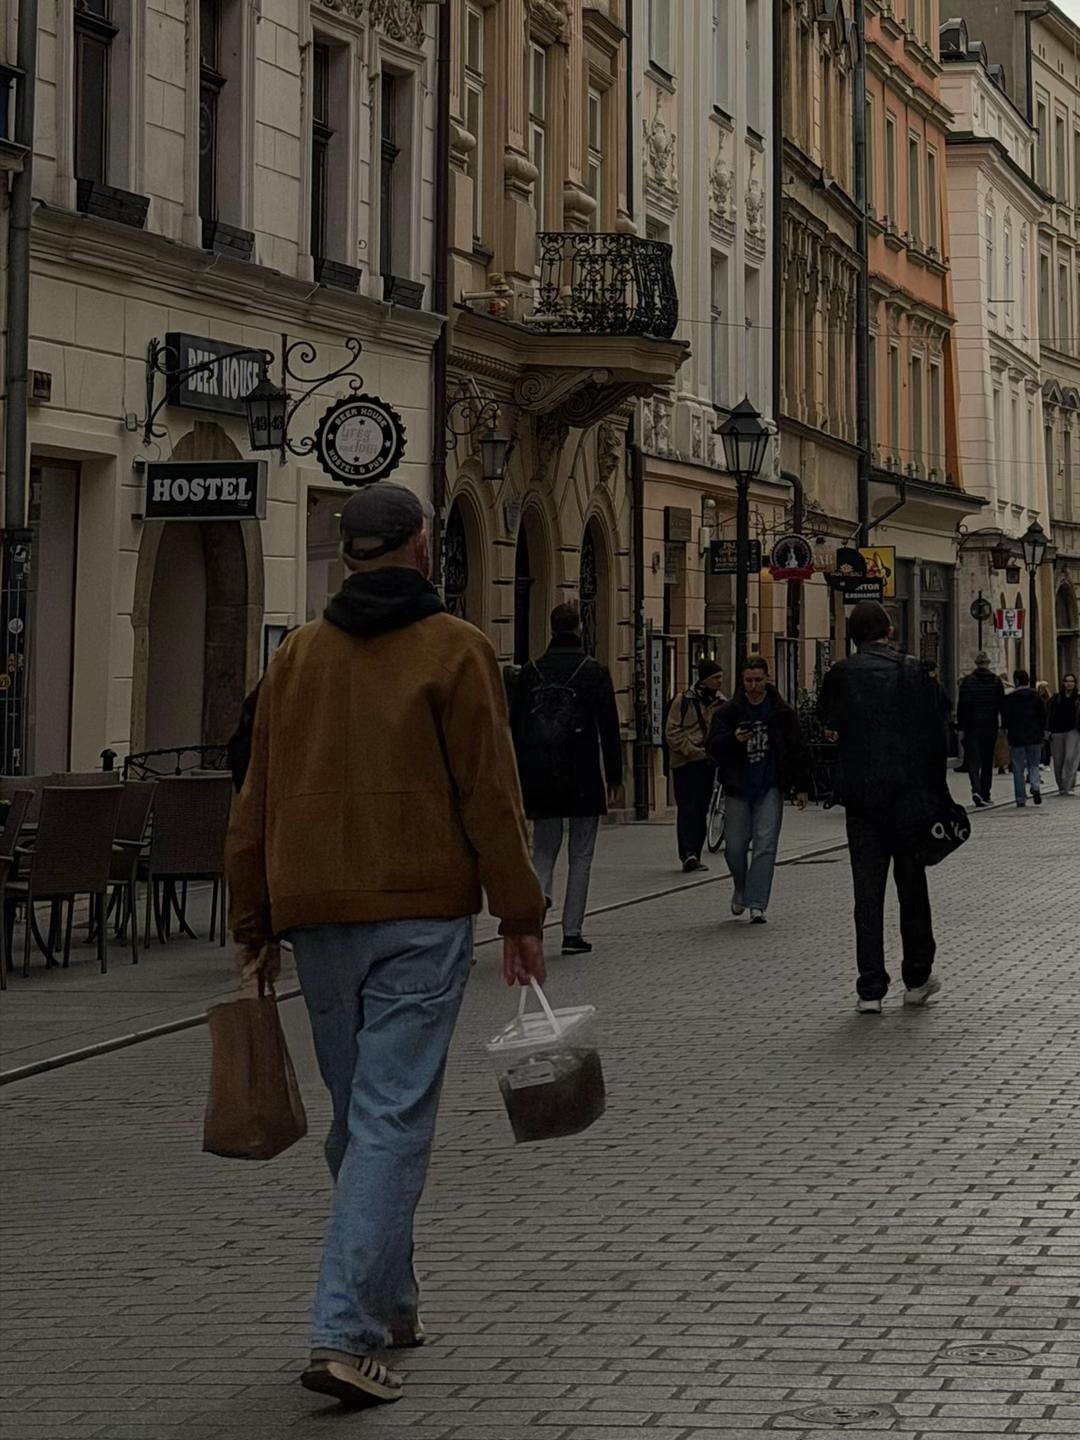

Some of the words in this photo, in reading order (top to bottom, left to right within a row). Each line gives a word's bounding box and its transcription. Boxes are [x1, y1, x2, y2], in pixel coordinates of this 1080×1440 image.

[187, 347, 219, 397] BEER
[222, 357, 260, 400] HOUSE
[334, 408, 358, 426] BEER
[360, 407, 388, 428] HOUSE
[328, 449, 356, 474] HOSTEL
[368, 456, 385, 472] PUB
[151, 477, 253, 502] HOSTEL
